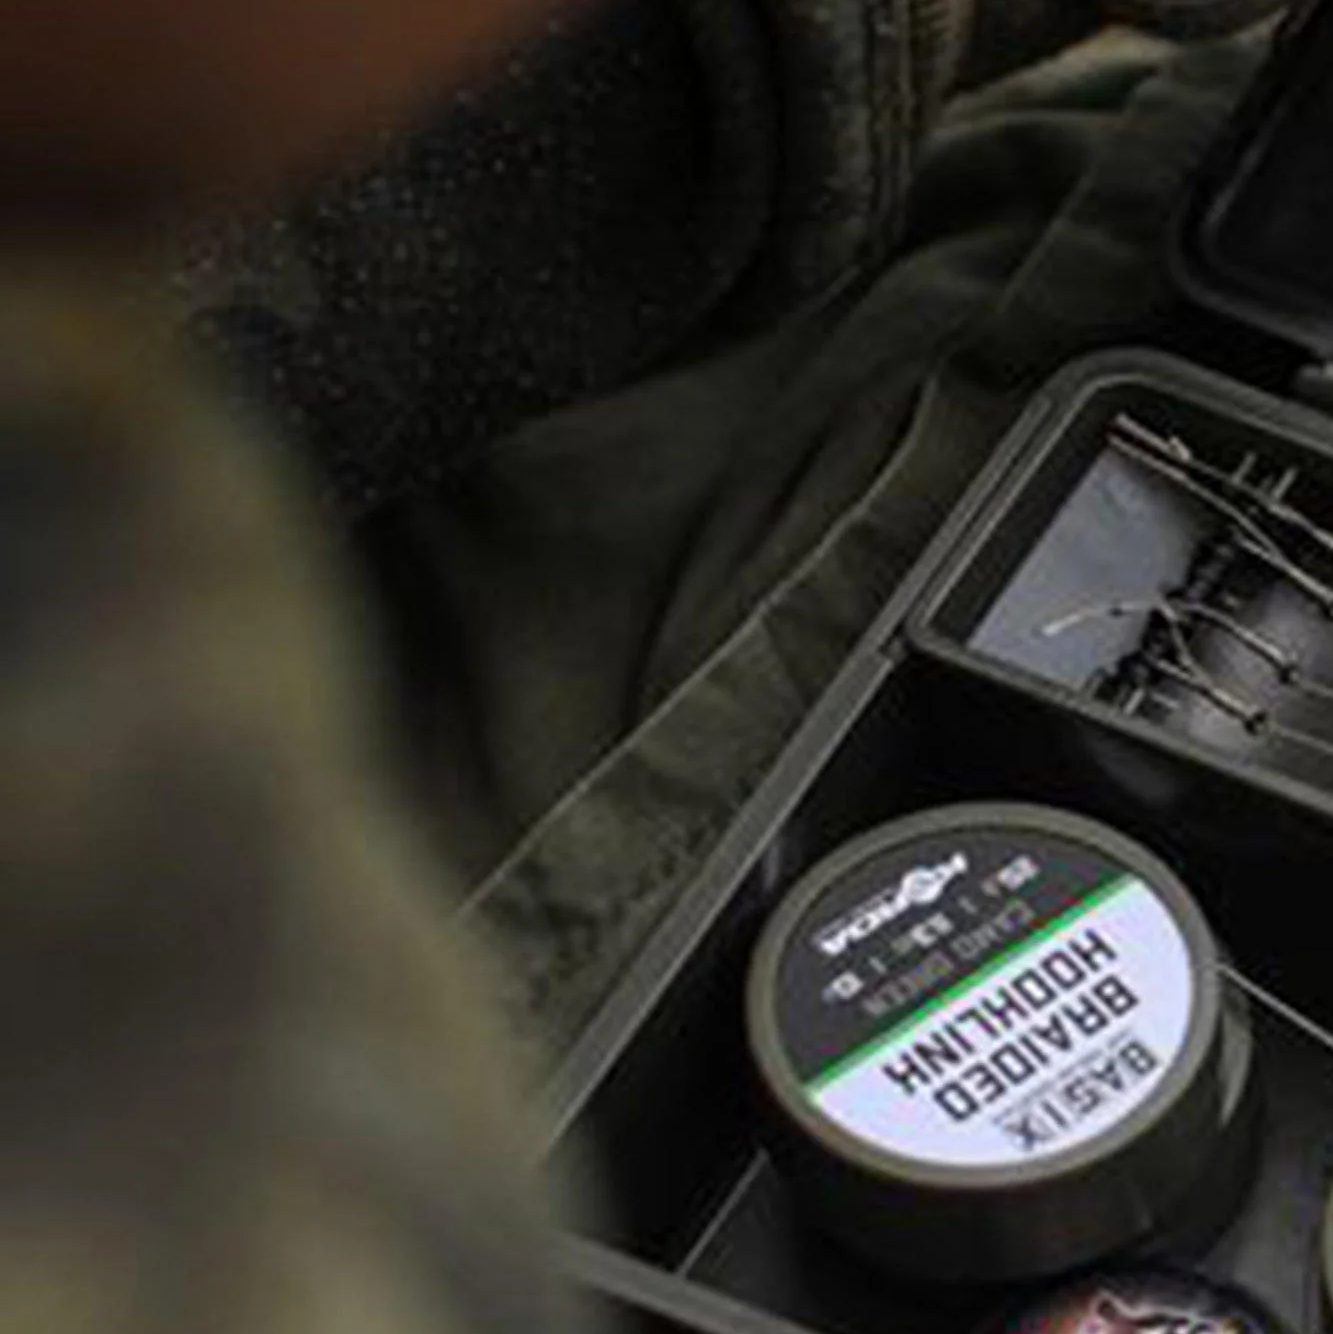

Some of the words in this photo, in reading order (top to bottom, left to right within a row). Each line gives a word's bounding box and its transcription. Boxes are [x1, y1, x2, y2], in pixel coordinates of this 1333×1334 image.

[881, 929, 1119, 1096] HOOKLINK
[934, 973, 1139, 1121] BRAIDED
[1005, 1038, 1160, 1151] BASIX
